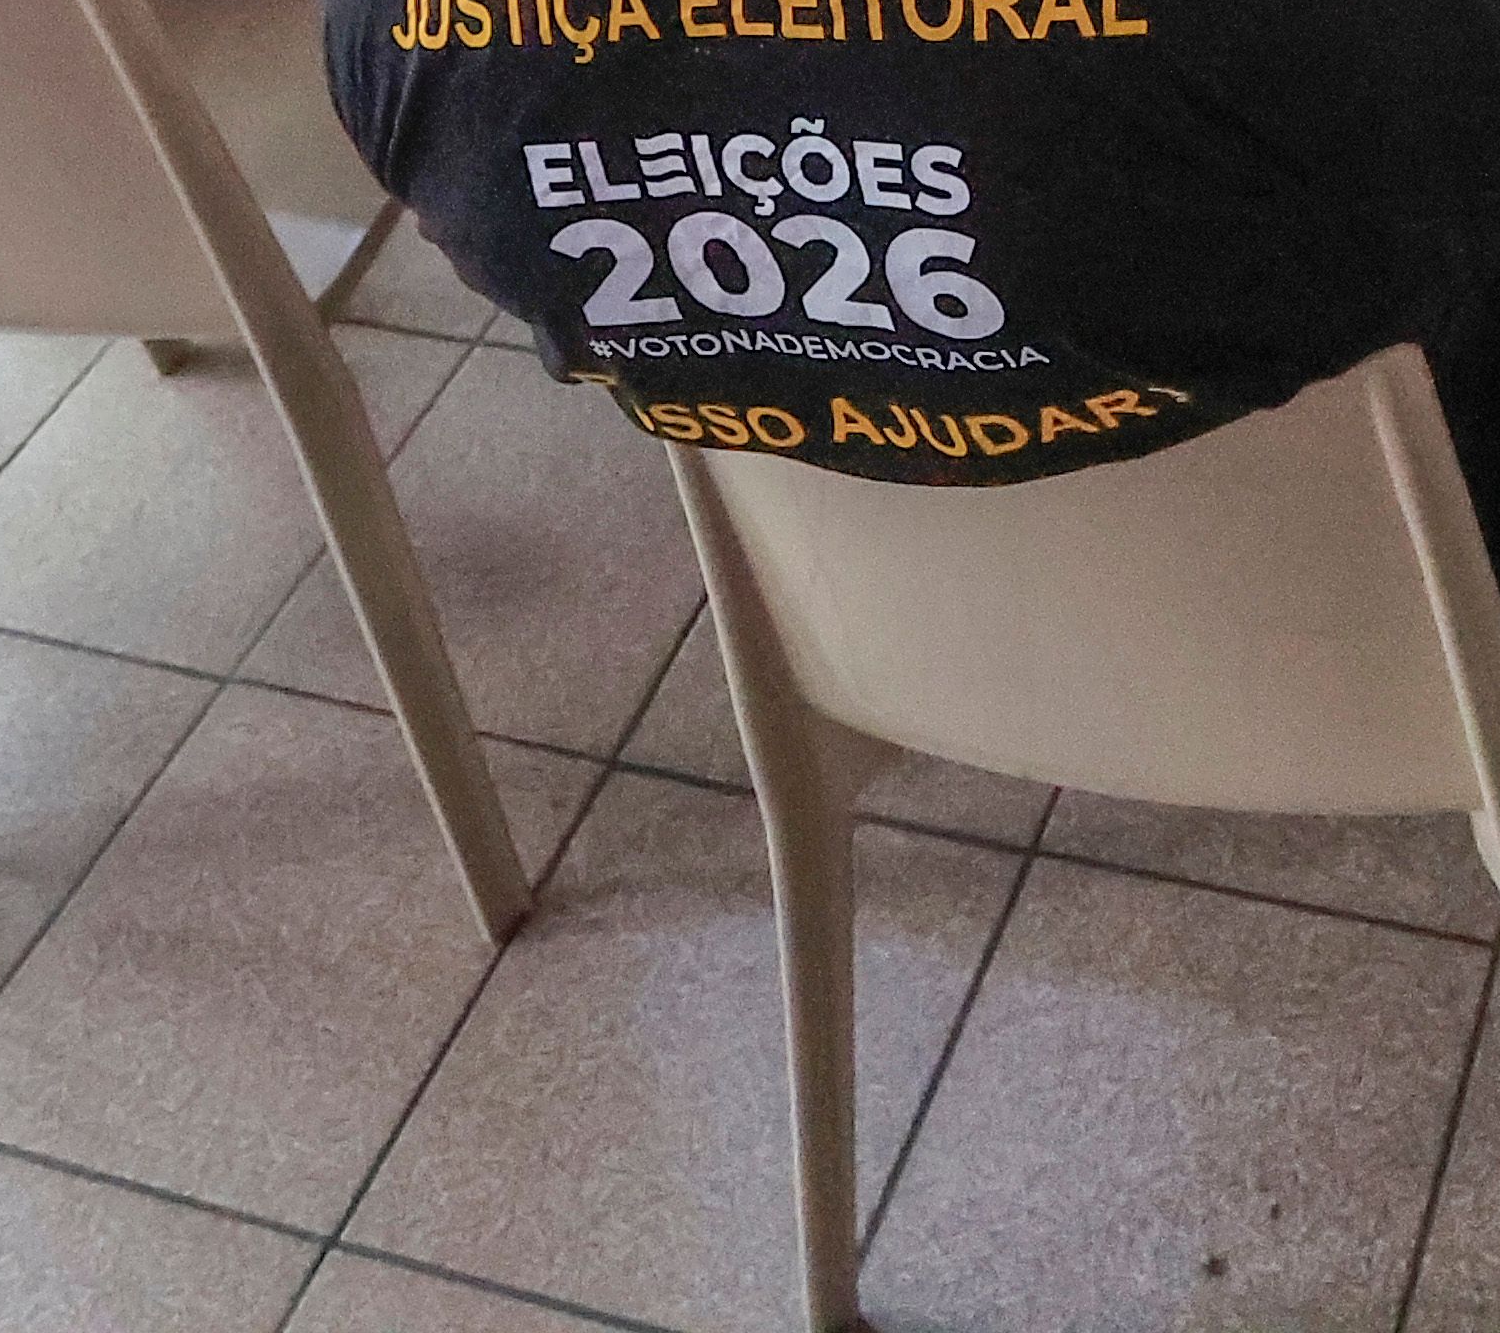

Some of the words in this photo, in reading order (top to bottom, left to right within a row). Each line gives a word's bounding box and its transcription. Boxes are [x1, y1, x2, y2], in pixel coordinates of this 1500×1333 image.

[523, 117, 972, 217] ELEIÇÕES
[549, 211, 1006, 341] 2026
[589, 328, 1051, 372] #VOTONADEMOCRACIA
